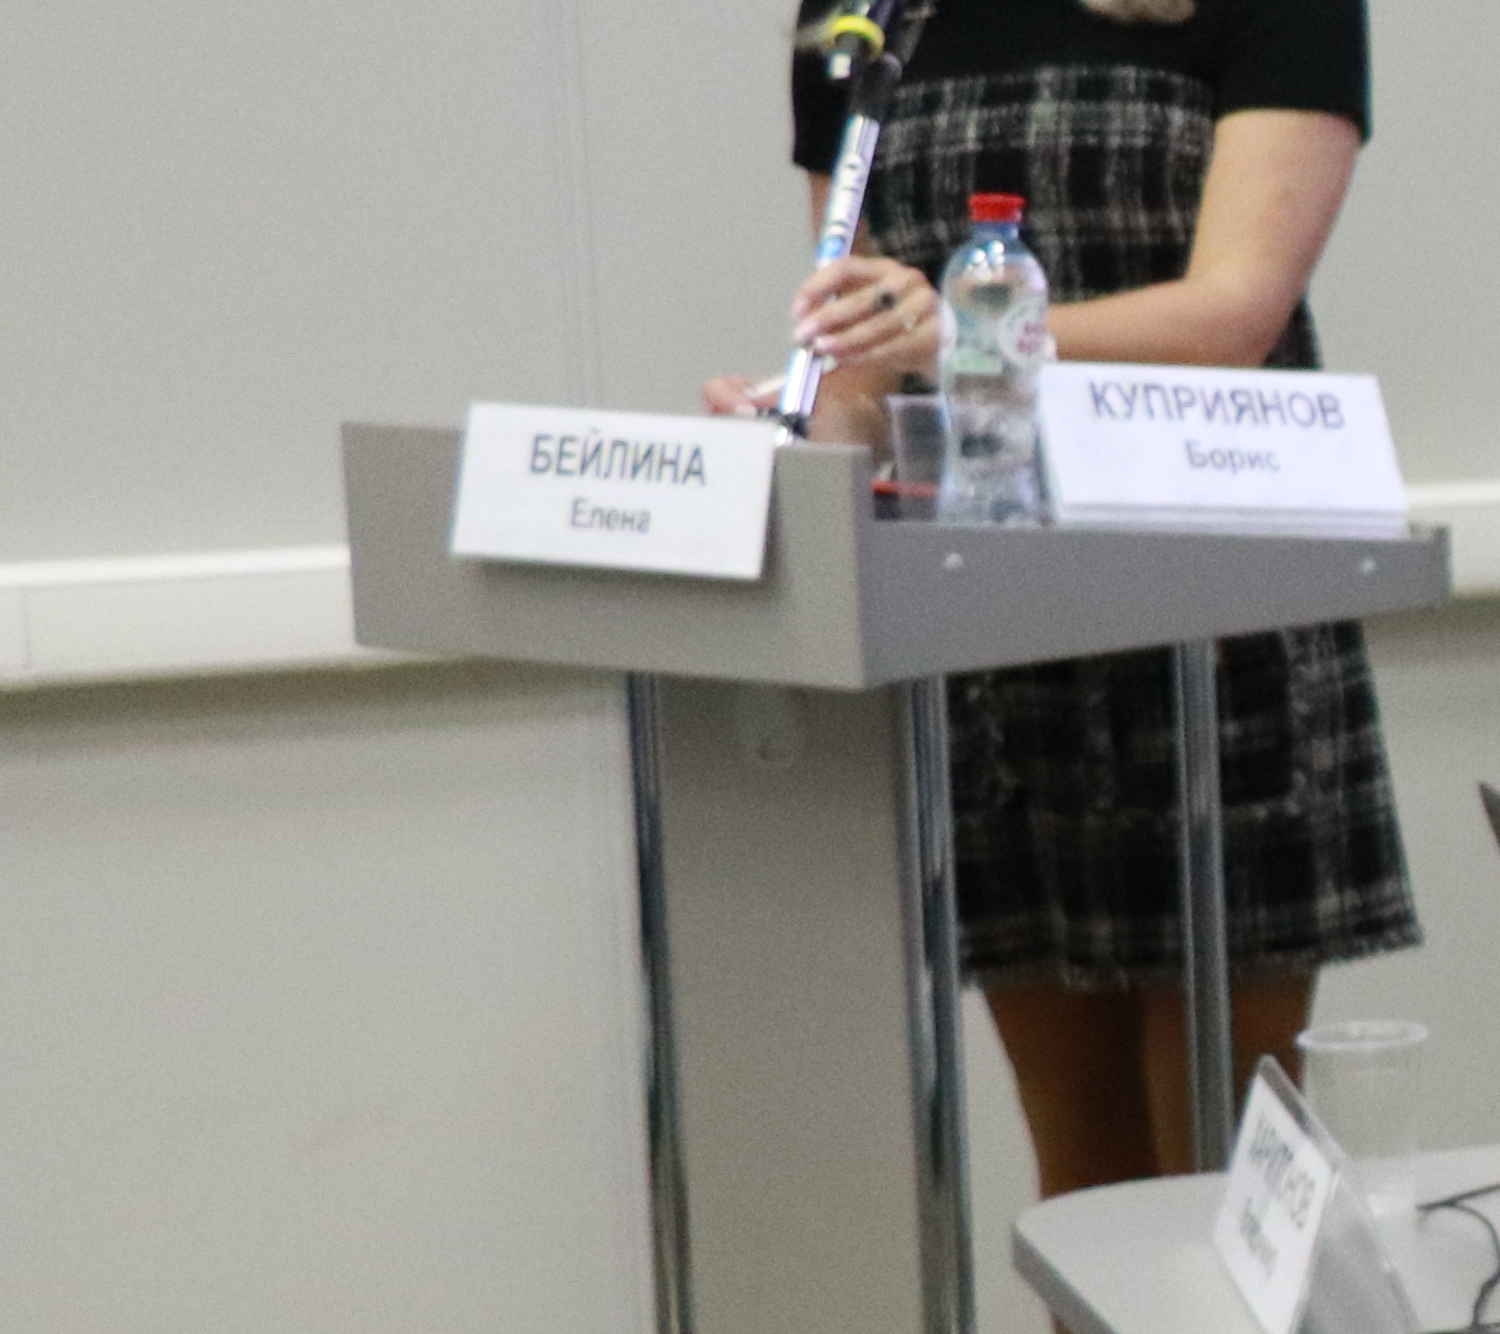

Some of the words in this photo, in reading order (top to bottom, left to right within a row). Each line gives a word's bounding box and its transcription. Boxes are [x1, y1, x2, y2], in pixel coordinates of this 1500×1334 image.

[1088, 380, 1346, 430] КУПРИЯНОВ
[529, 427, 707, 486] БЕЙЛИНА
[1184, 439, 1281, 474] Борис
[570, 497, 652, 533] Елена
